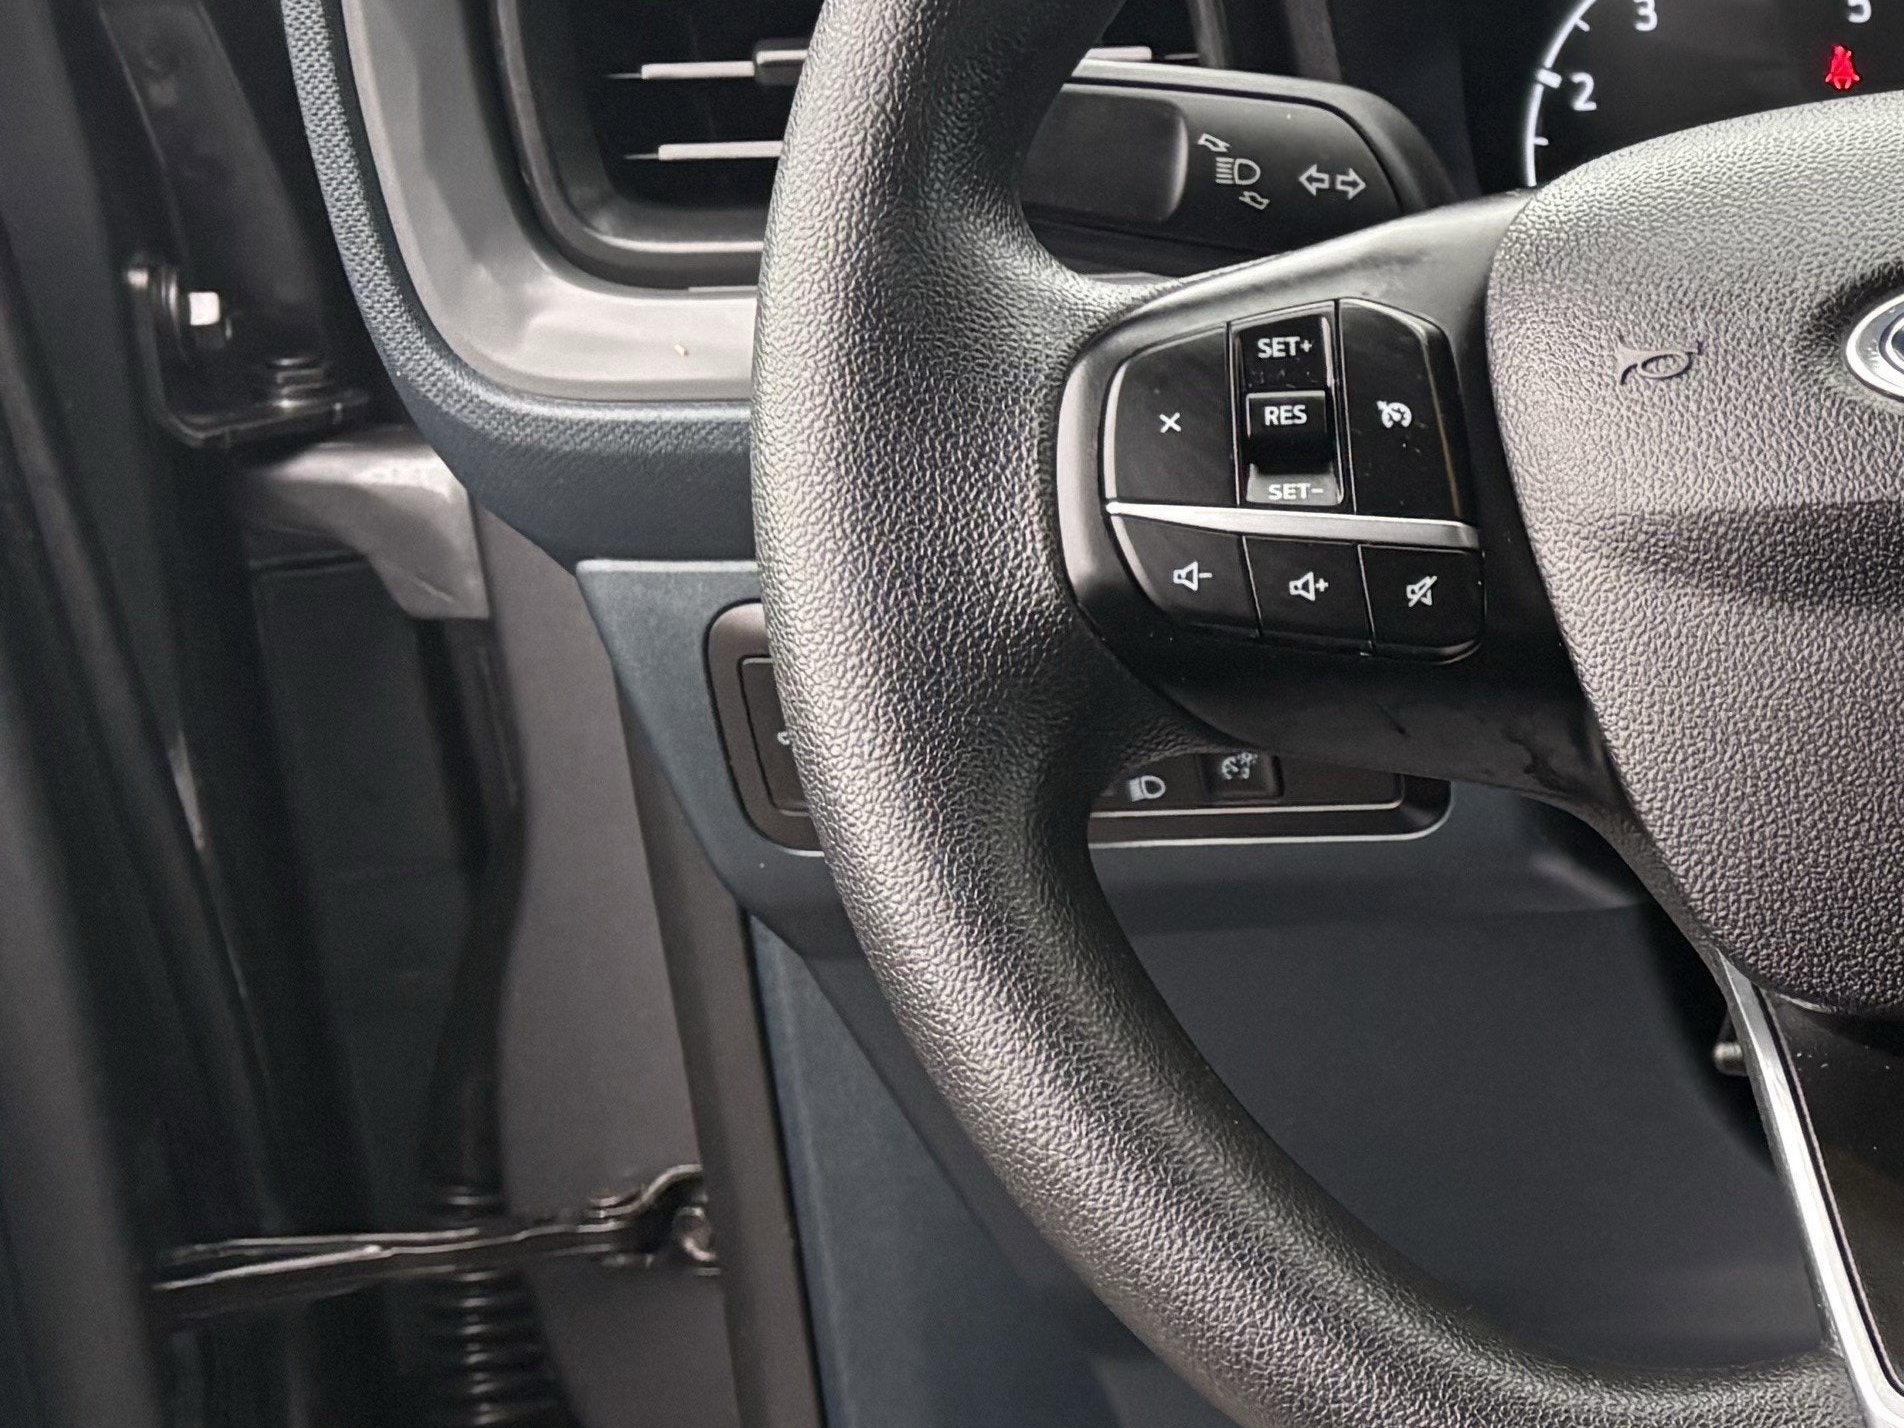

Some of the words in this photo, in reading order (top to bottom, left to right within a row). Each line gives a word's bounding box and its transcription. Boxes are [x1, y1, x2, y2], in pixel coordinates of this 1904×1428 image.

[1570, 73, 1598, 110] 2
[1256, 337, 1314, 359] SET+
[1263, 404, 1308, 427] RES
[1267, 482, 1325, 501] SET-
